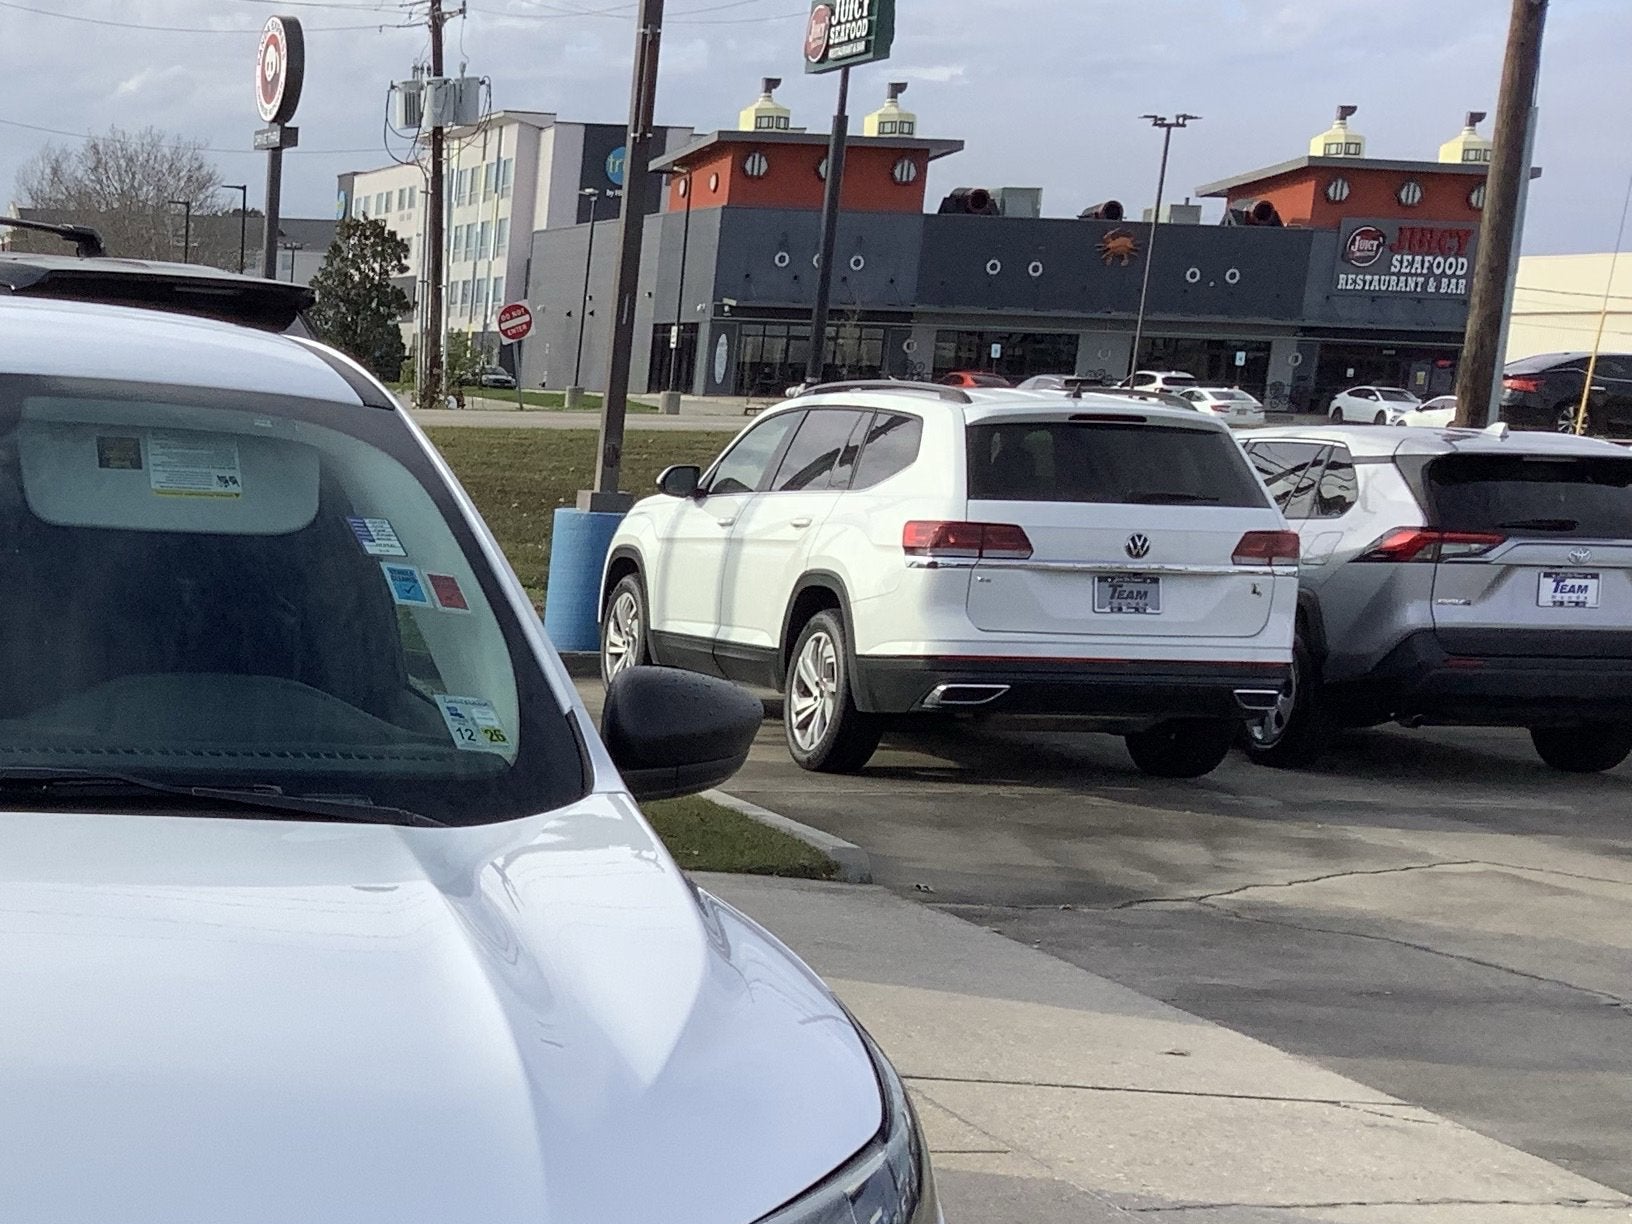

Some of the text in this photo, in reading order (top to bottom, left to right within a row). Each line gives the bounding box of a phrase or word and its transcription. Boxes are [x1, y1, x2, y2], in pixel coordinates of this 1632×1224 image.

[829, 18, 868, 45] SEAFOOD
[608, 153, 624, 173] tr
[1389, 226, 1472, 255] JUICY
[1390, 255, 1468, 276] SEAFOOD
[1337, 274, 1467, 294] RESTAURANT & BAR
[501, 307, 525, 321] DO NOT
[507, 324, 527, 335] ENTER
[1552, 576, 1589, 595] TEAM
[456, 727, 477, 742] 12
